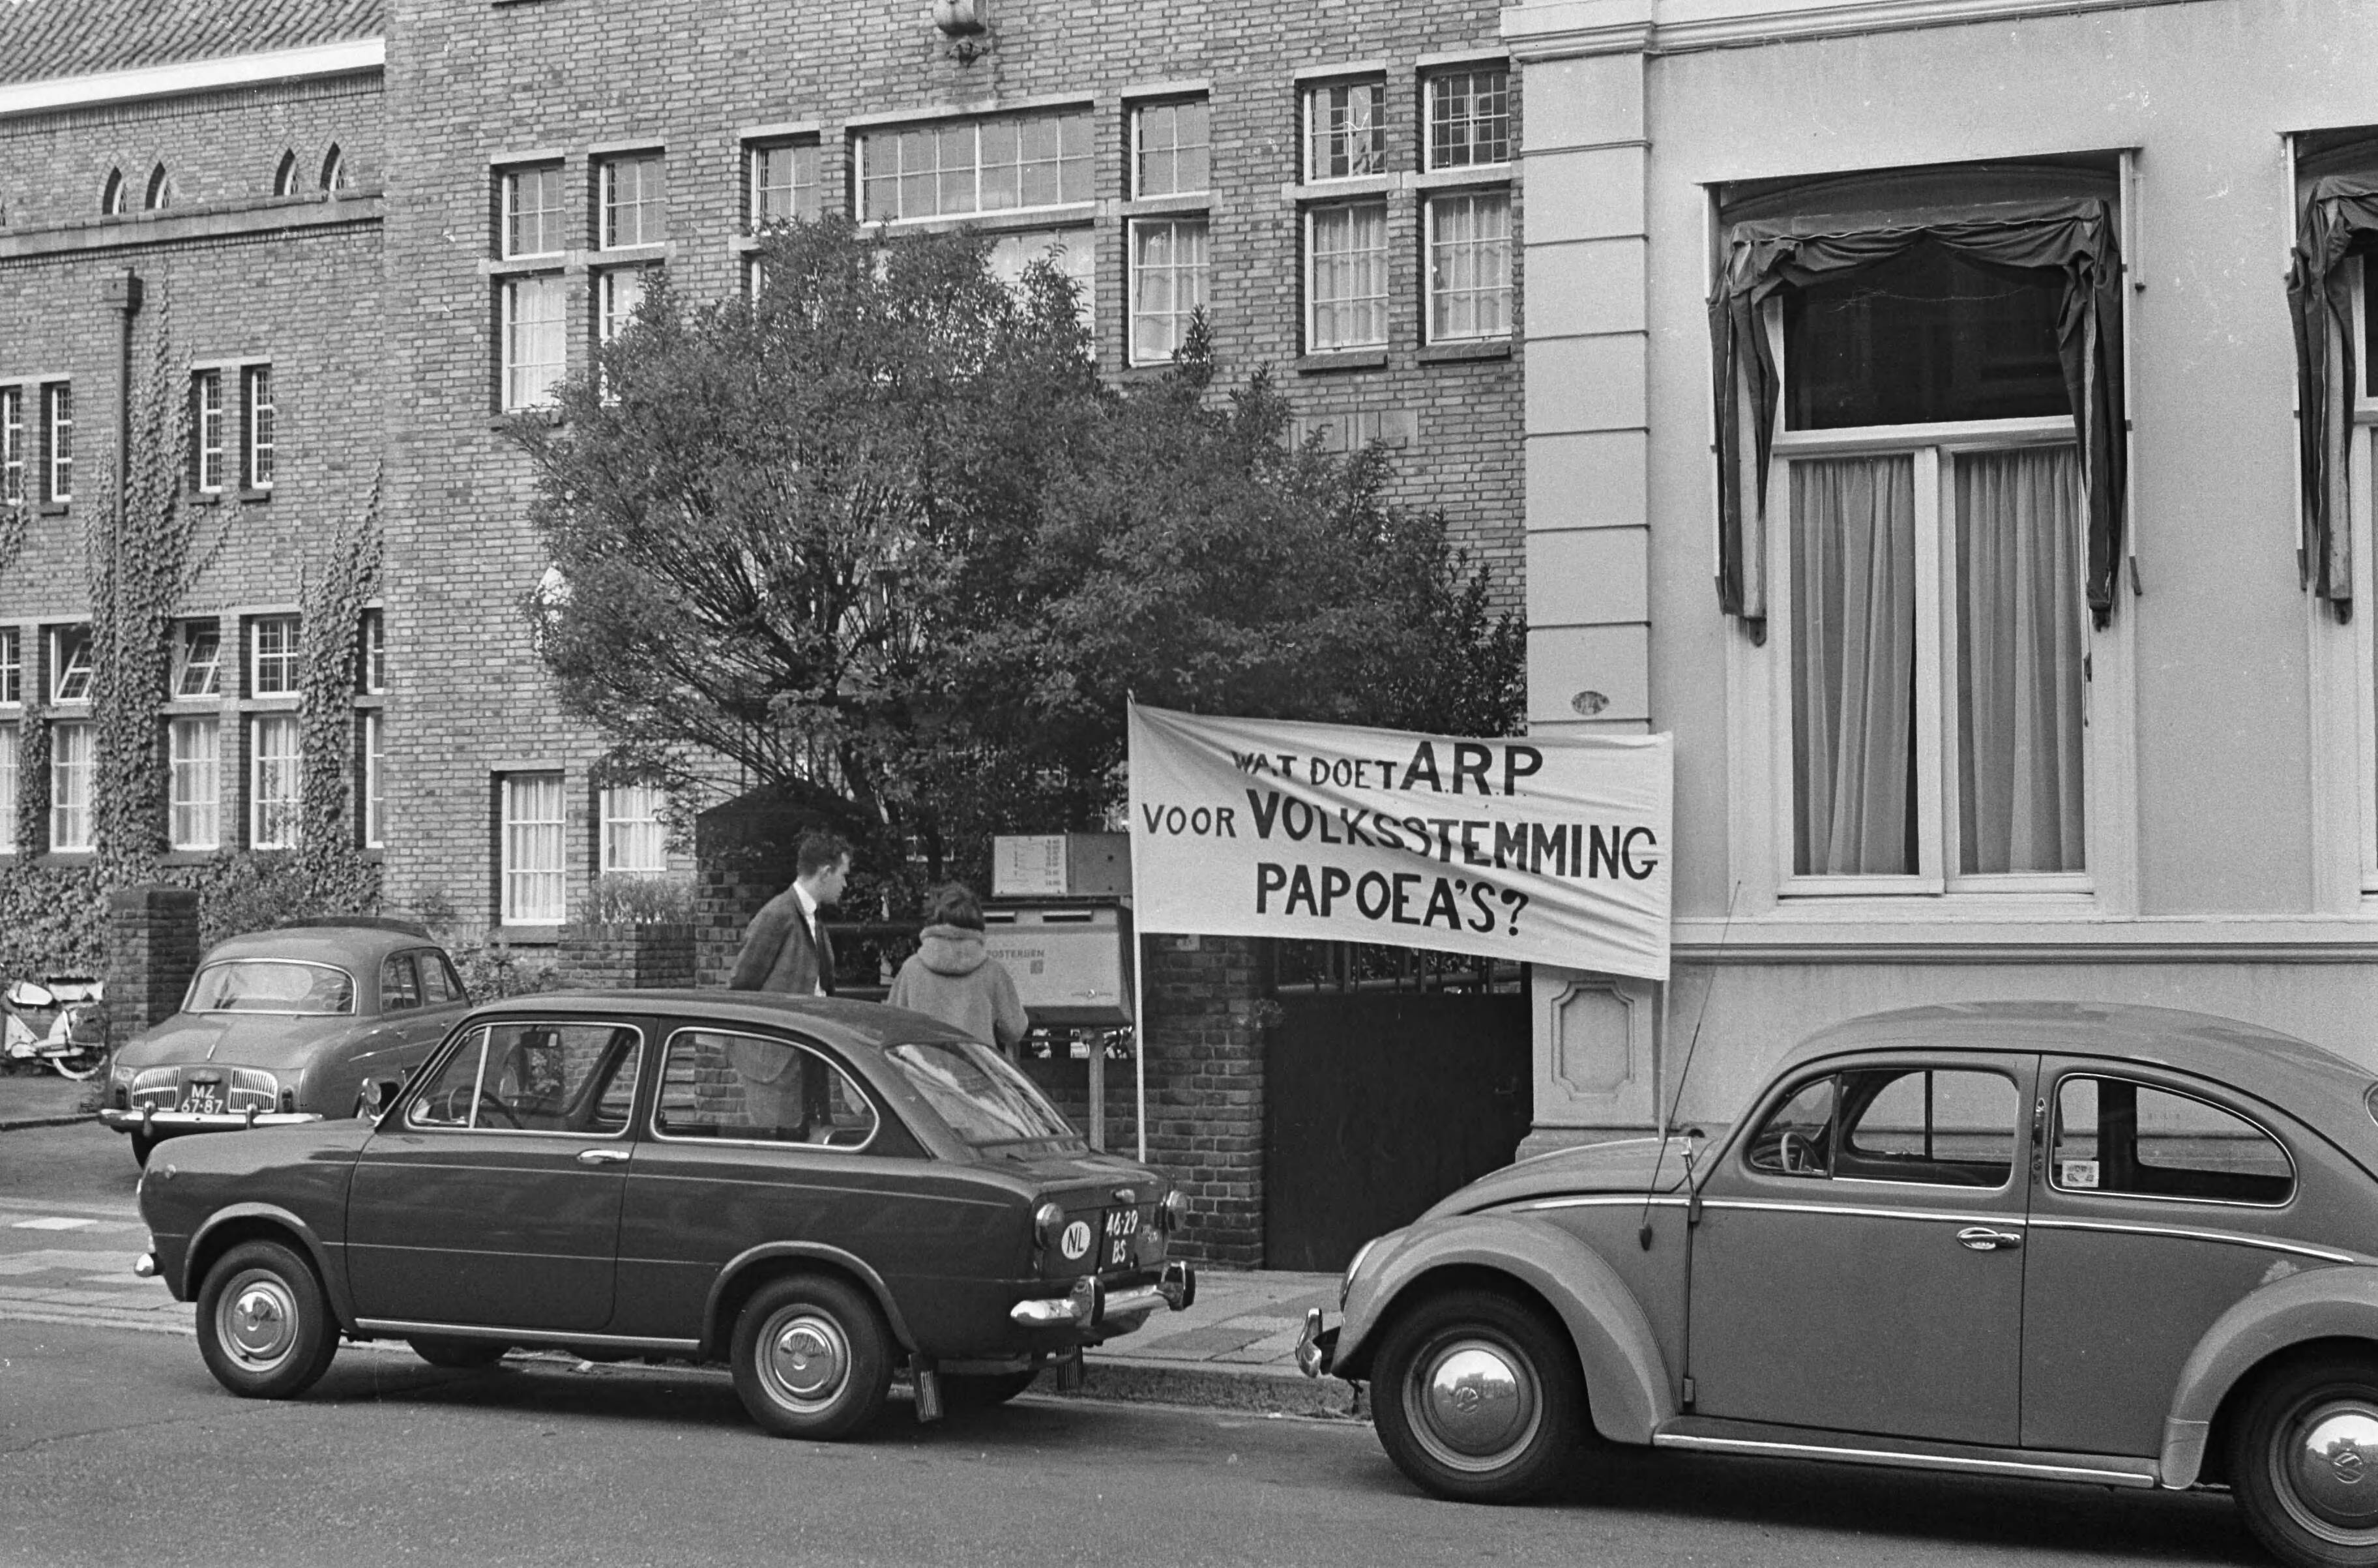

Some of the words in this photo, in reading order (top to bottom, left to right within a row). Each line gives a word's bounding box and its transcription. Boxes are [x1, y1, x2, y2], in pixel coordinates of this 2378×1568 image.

[1229, 750, 1297, 779] WAT
[1310, 757, 1398, 789] DOET
[1142, 804, 1236, 837] VOOR
[1246, 788, 1658, 880] VOLKSSTEMMING
[1257, 862, 1530, 936] PAPOEA'S?
[192, 1084, 215, 1099] MZ
[1066, 1227, 1083, 1255] NL
[1112, 1239, 1126, 1264] BS
